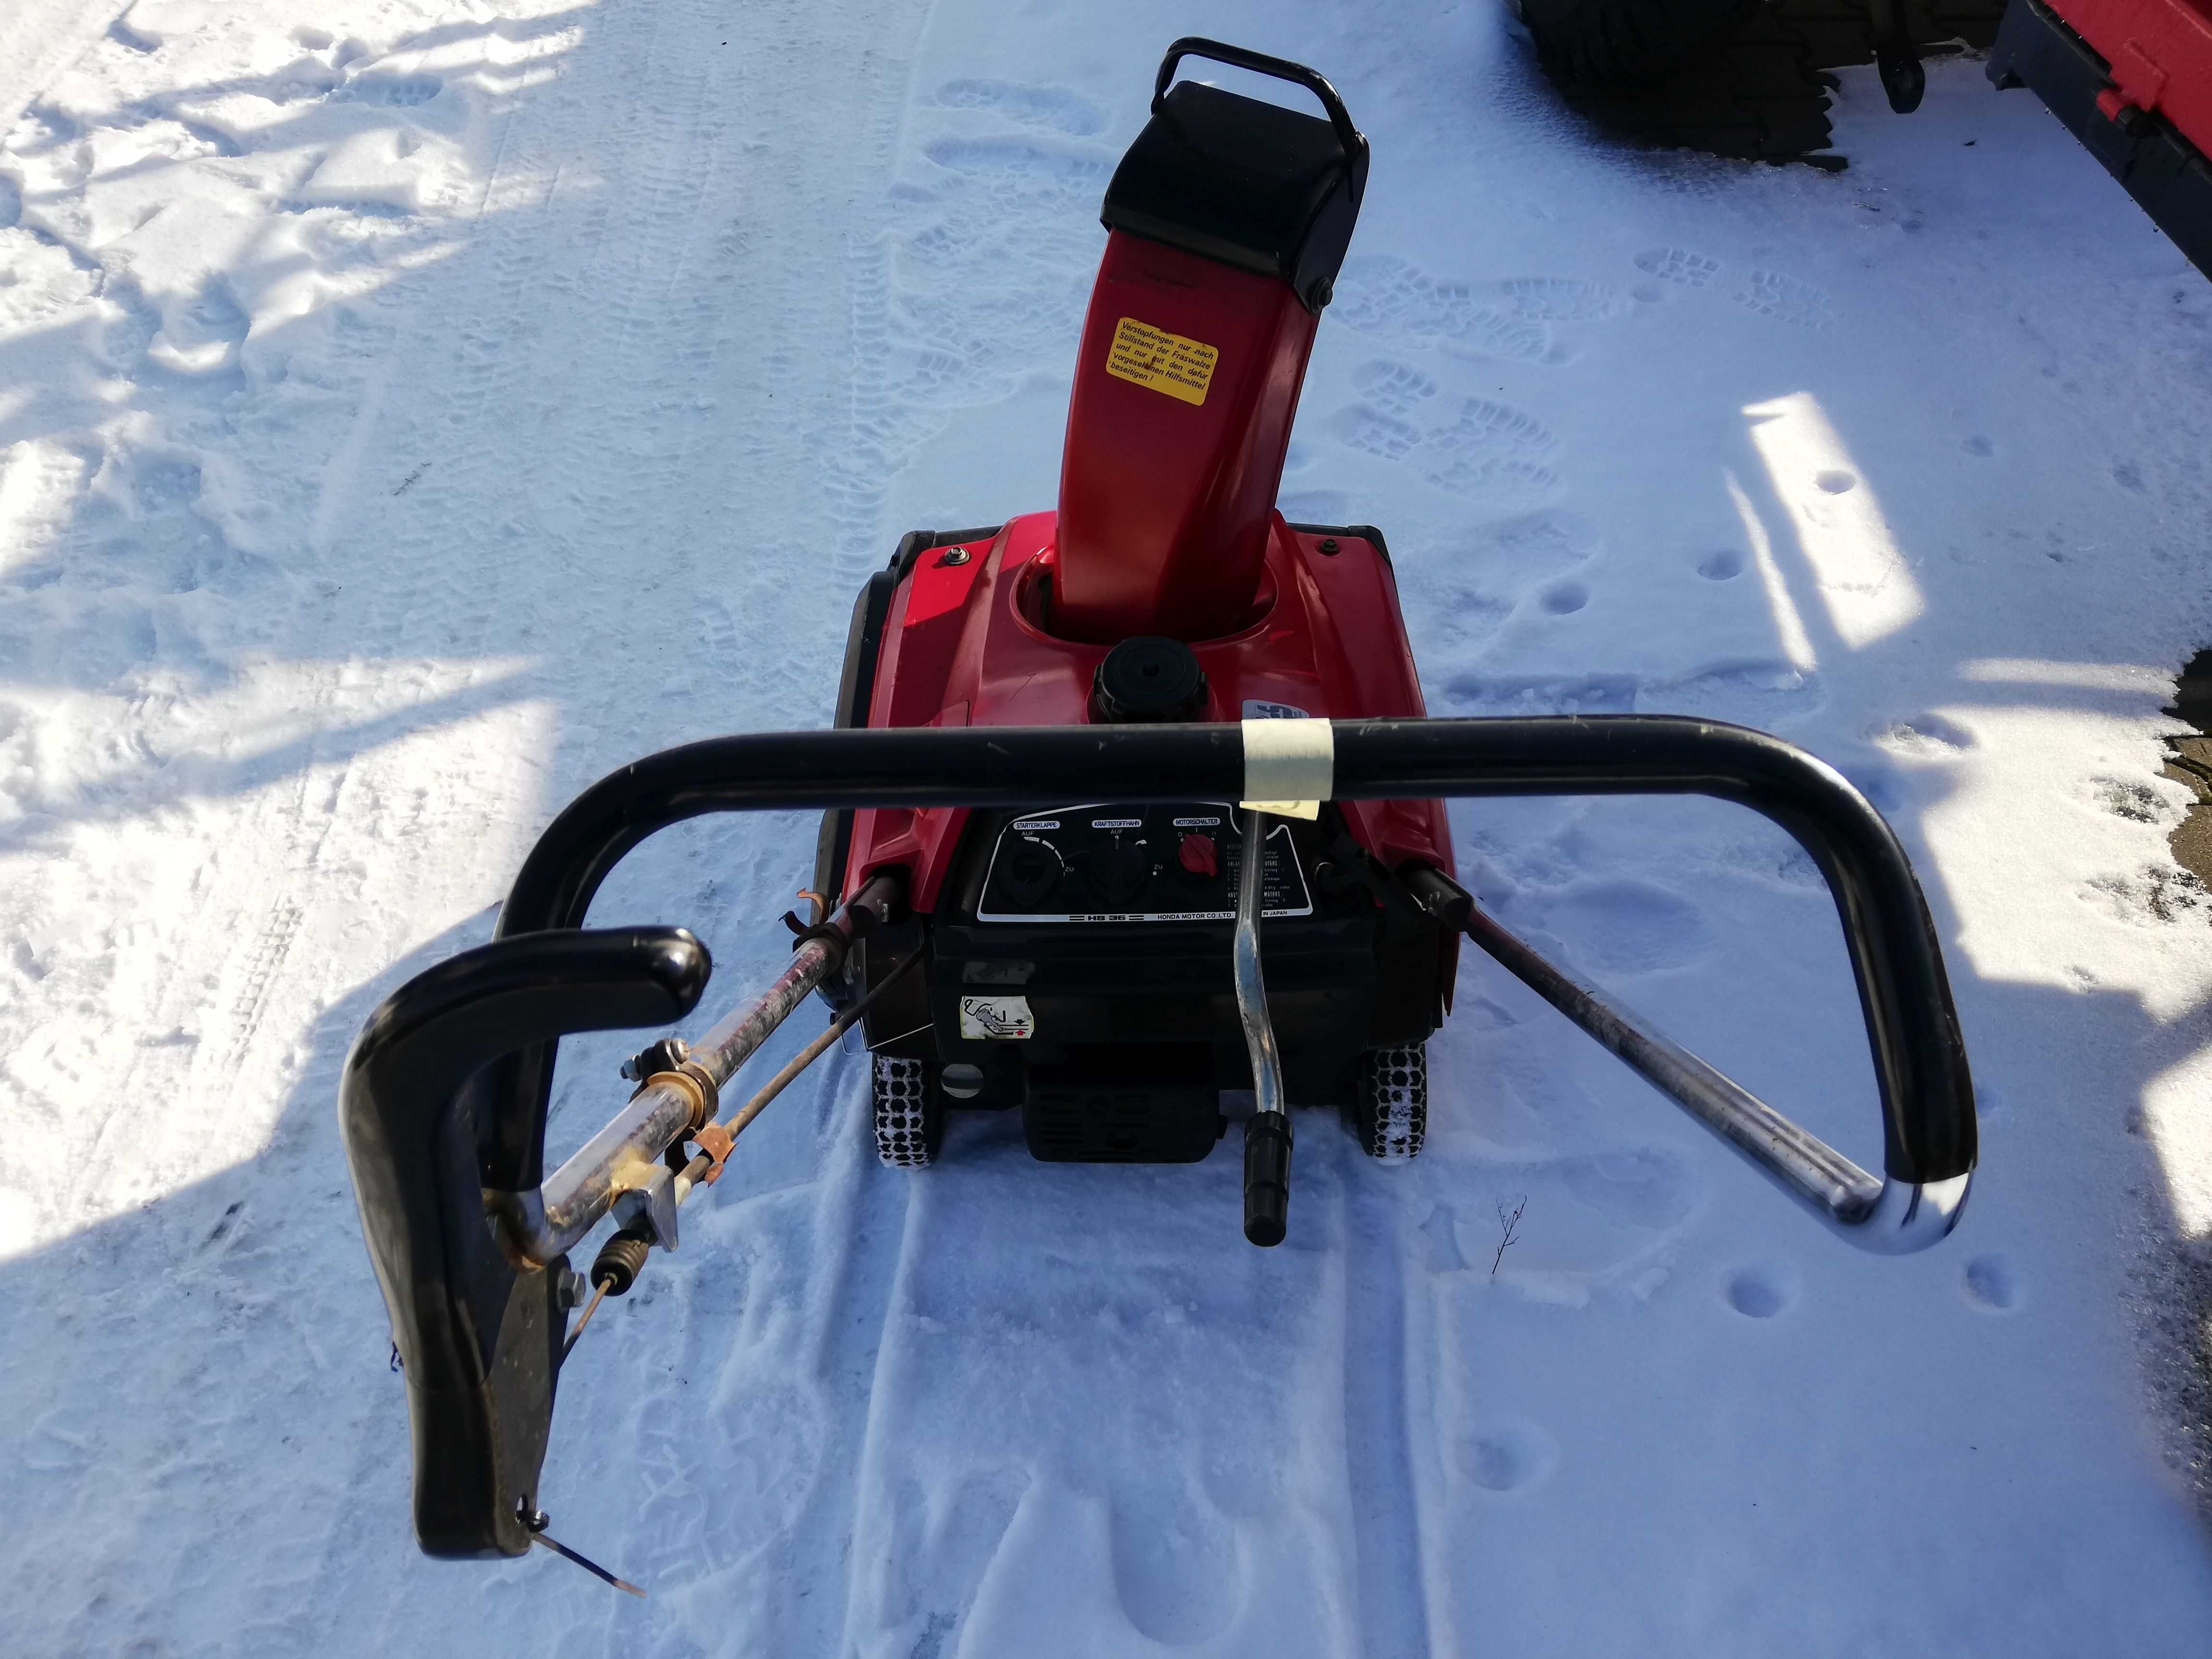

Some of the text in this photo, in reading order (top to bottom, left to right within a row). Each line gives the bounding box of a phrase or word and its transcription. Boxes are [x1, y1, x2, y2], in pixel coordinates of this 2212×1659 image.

[1119, 332, 1154, 349] Stillstand
[1156, 346, 1169, 354] der
[1122, 321, 1214, 360] Verstopfungen nur nach
[1116, 343, 1131, 352] und
[1134, 350, 1147, 358] nur
[1152, 355, 1165, 364] mit
[1169, 361, 1183, 371] den
[1110, 361, 1148, 380] beseitigen
[1165, 370, 1206, 390] Hilfsmittel
